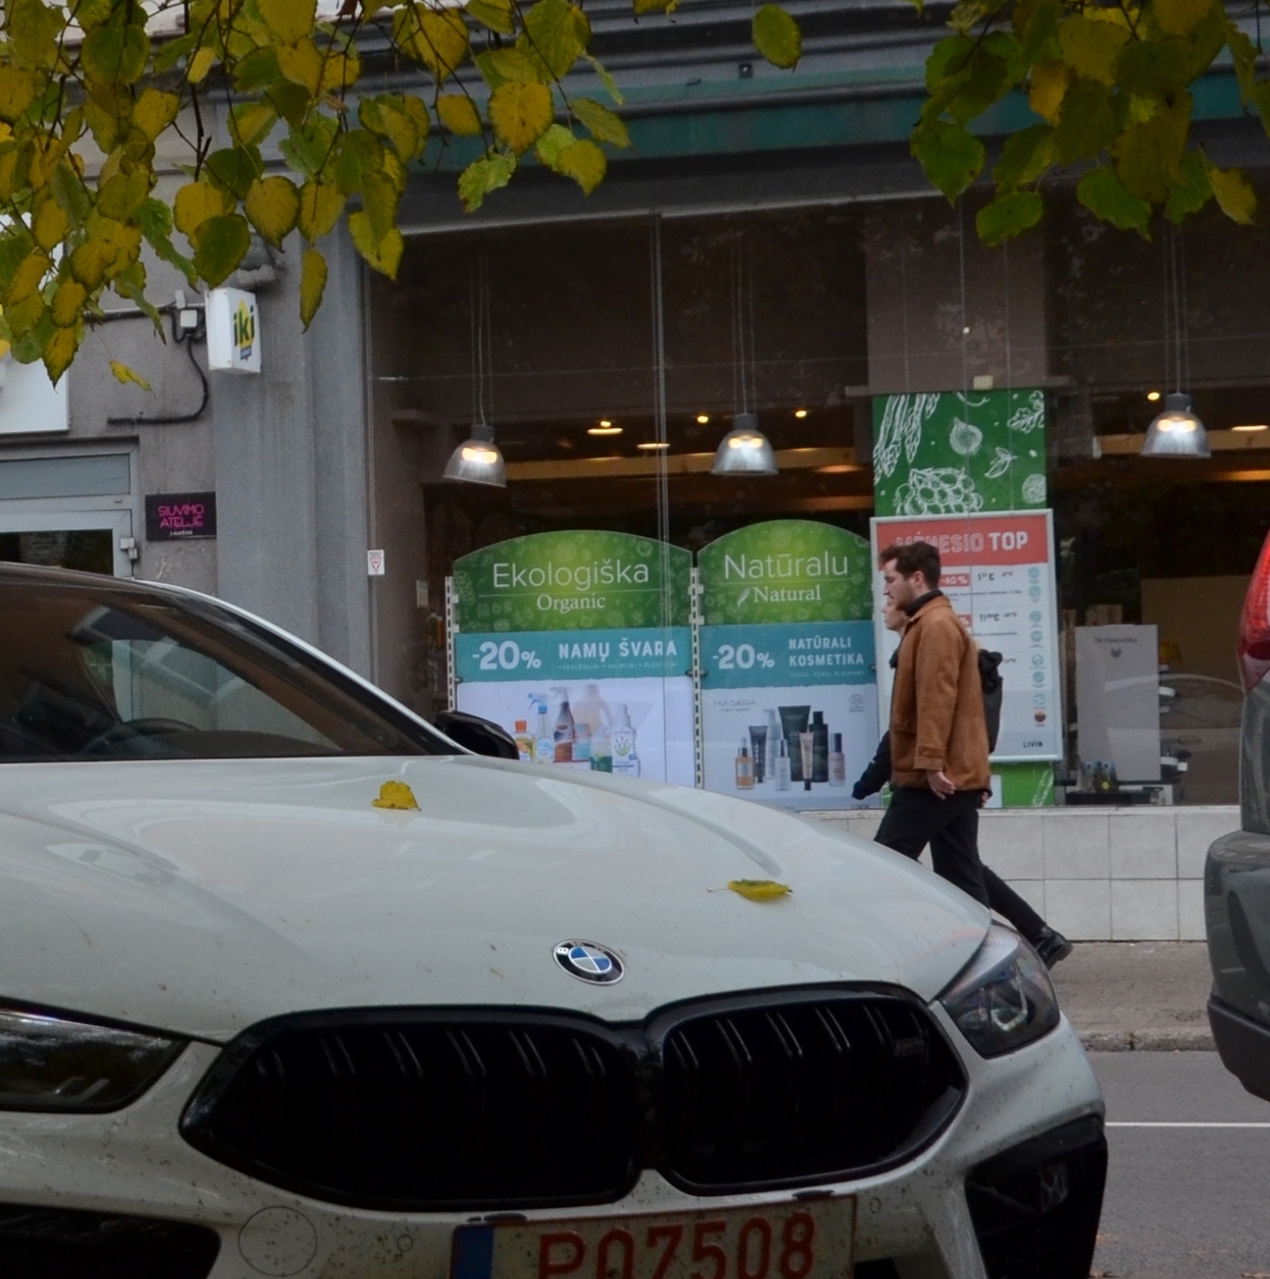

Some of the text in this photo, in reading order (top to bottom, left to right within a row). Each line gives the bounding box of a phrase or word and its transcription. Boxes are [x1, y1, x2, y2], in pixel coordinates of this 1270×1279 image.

[234, 304, 255, 347] iki
[988, 531, 1028, 551] TOP
[493, 559, 650, 591] Ekologiška
[724, 550, 849, 579] Natūralu
[537, 594, 606, 613] Organic
[754, 585, 821, 602] Natural
[473, 640, 542, 670] -20%
[558, 637, 677, 662] NAMŲ ŠVARA
[788, 635, 852, 650] NATŪRALI
[712, 643, 775, 670] -20%
[789, 653, 864, 667] KOSMETIKA
